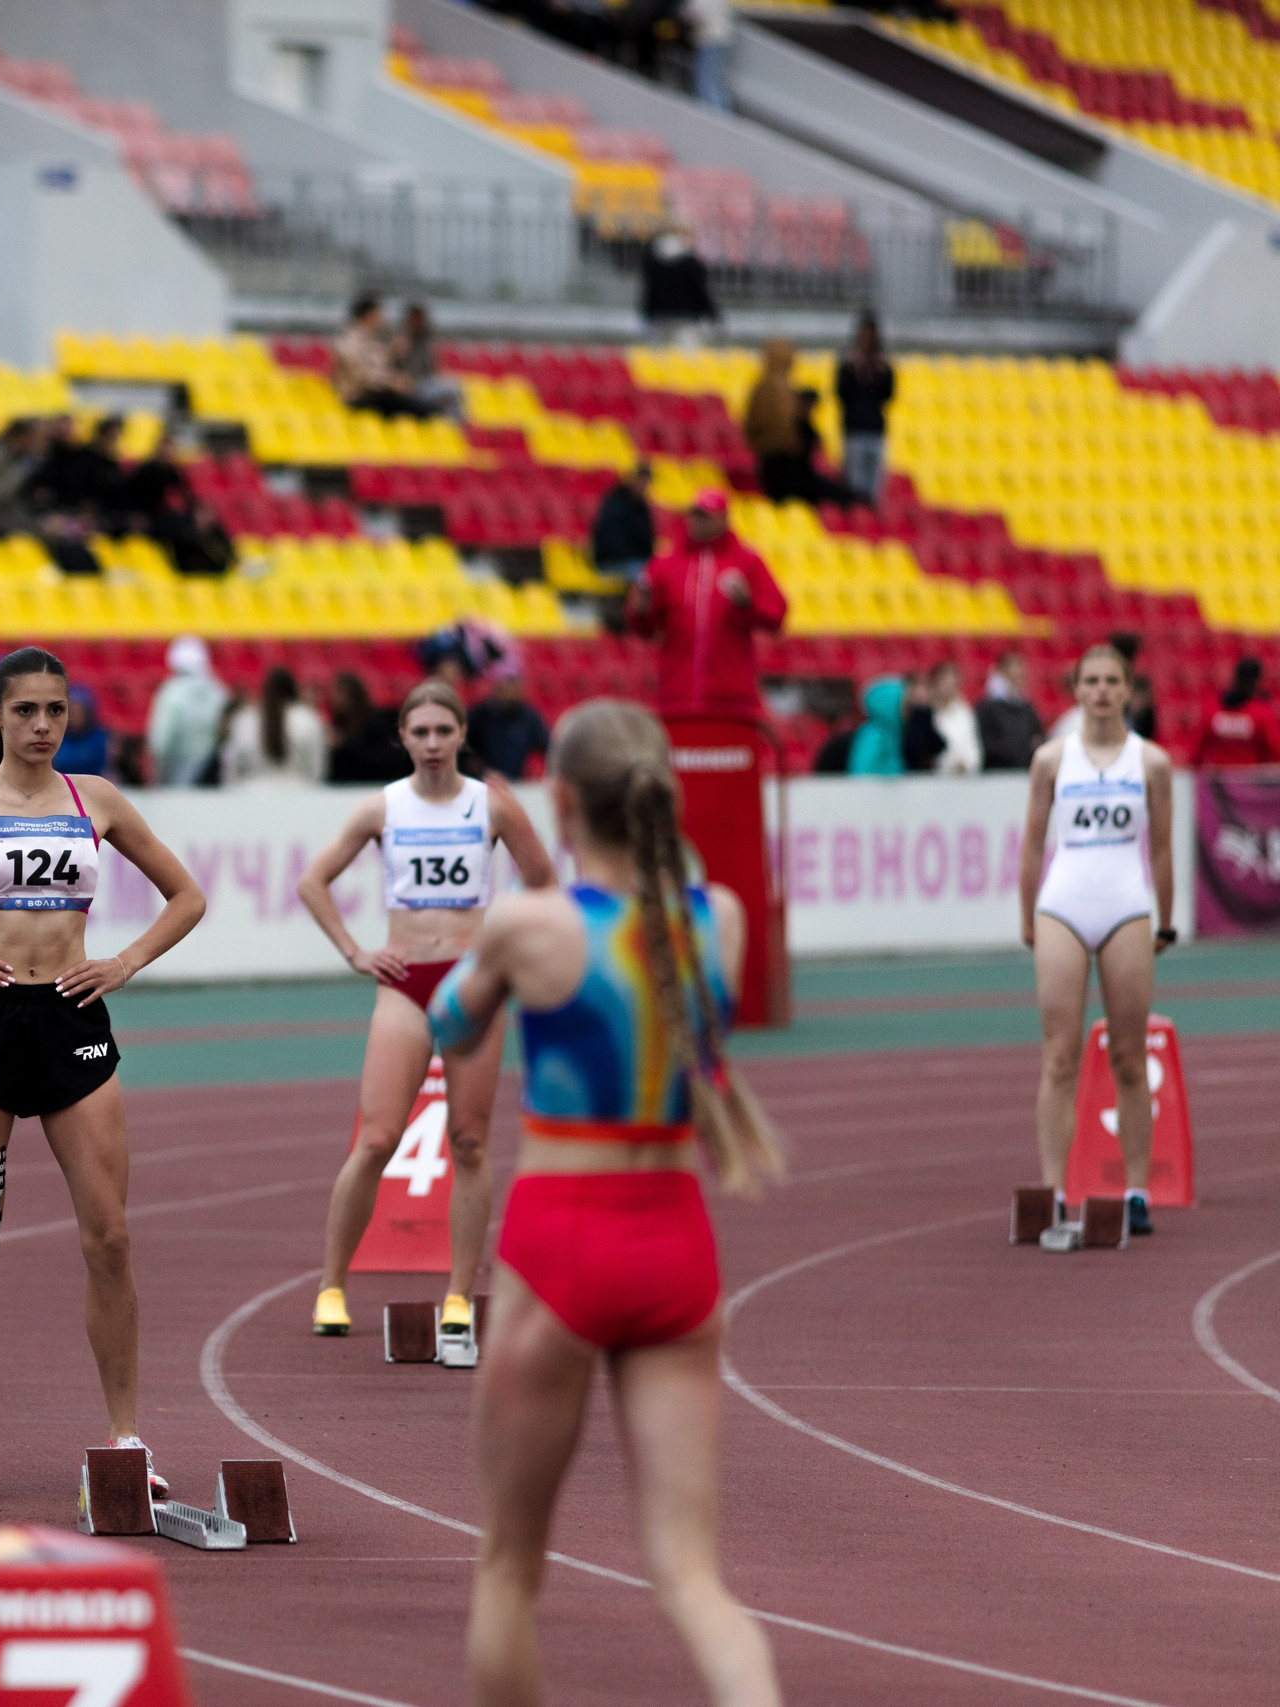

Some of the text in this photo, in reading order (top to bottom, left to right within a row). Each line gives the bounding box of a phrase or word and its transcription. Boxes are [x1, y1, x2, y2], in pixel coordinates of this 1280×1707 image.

[1073, 805, 1131, 829] 490
[5, 849, 80, 886] 124
[409, 856, 470, 886] 136
[27, 900, 57, 908] ВФЛА
[73, 1042, 108, 1061] RAY
[381, 1099, 449, 1197] 4
